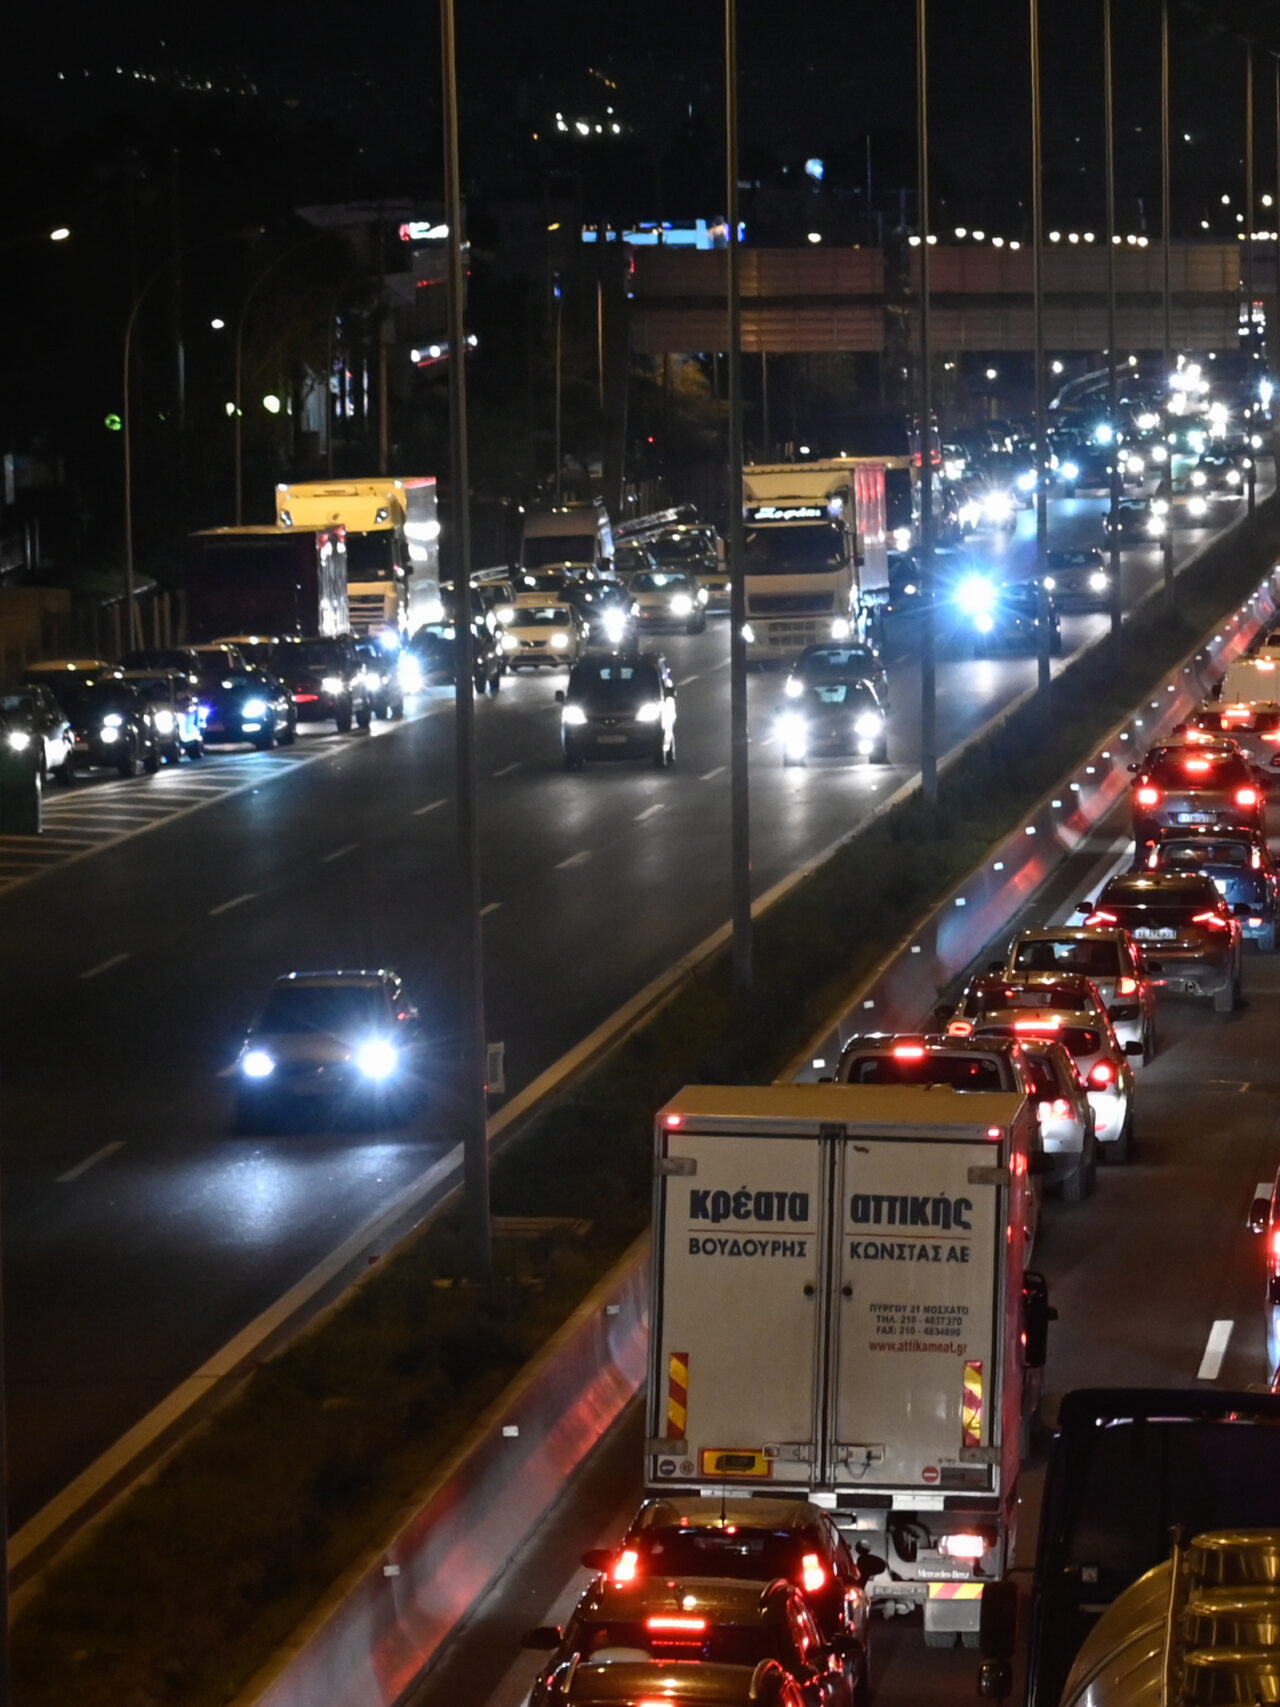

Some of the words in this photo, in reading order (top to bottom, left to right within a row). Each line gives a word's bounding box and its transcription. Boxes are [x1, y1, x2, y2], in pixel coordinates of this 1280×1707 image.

[690, 1185, 809, 1224] κρέατα
[850, 1192, 973, 1231] αττικής
[688, 1237, 807, 1258] ΒΟΥΔΟΥΡΗΣ
[850, 1241, 943, 1262] ΚΩΝΣΤΑΣ
[946, 1245, 970, 1264] ΑΕ
[900, 1315, 917, 1325] 210
[923, 1304, 969, 1316] ΜΟΣΧΑΤΟ
[868, 1339, 968, 1357] www.attikameat.gr
